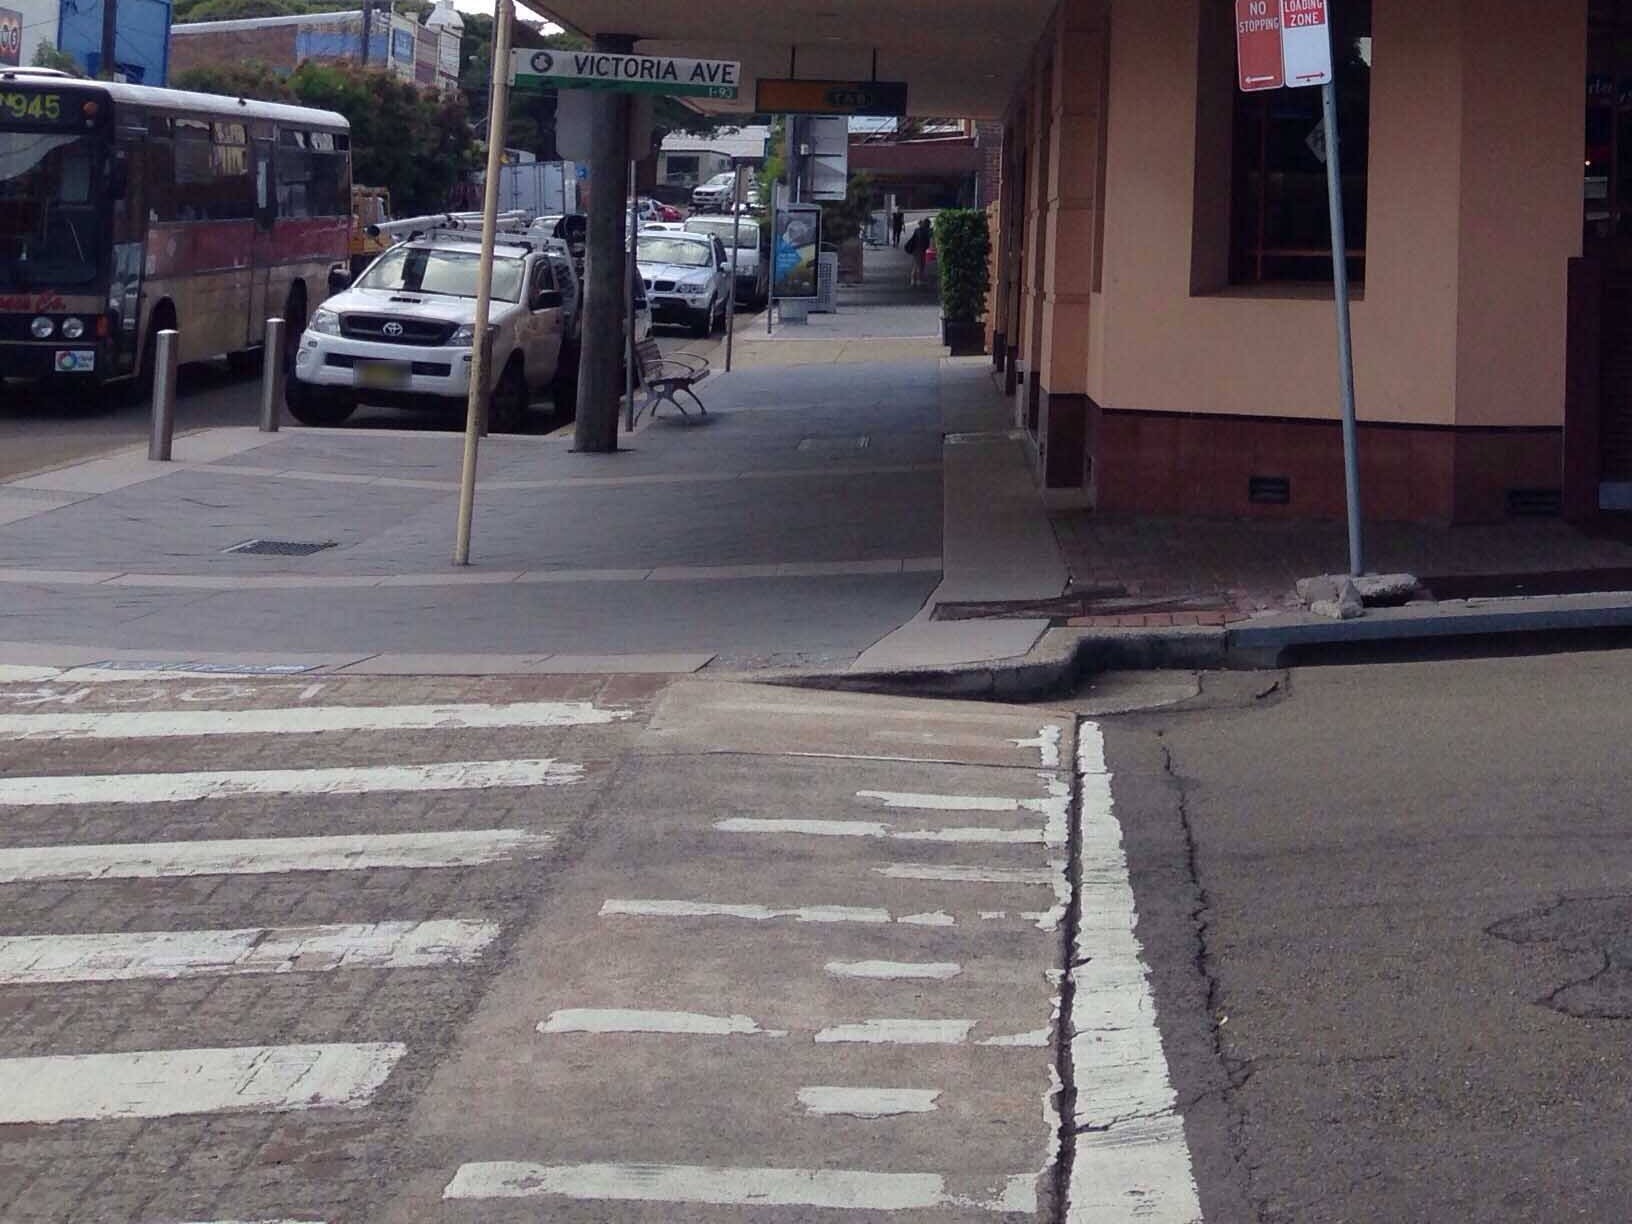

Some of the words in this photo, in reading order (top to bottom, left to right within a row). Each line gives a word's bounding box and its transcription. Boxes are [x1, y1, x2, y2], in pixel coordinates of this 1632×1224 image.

[1250, 0, 1267, 15] NO
[1239, 17, 1279, 33] STOPPING
[1290, 12, 1320, 27] ZONE
[574, 55, 678, 81] VICTORIA
[689, 63, 735, 84] AVE
